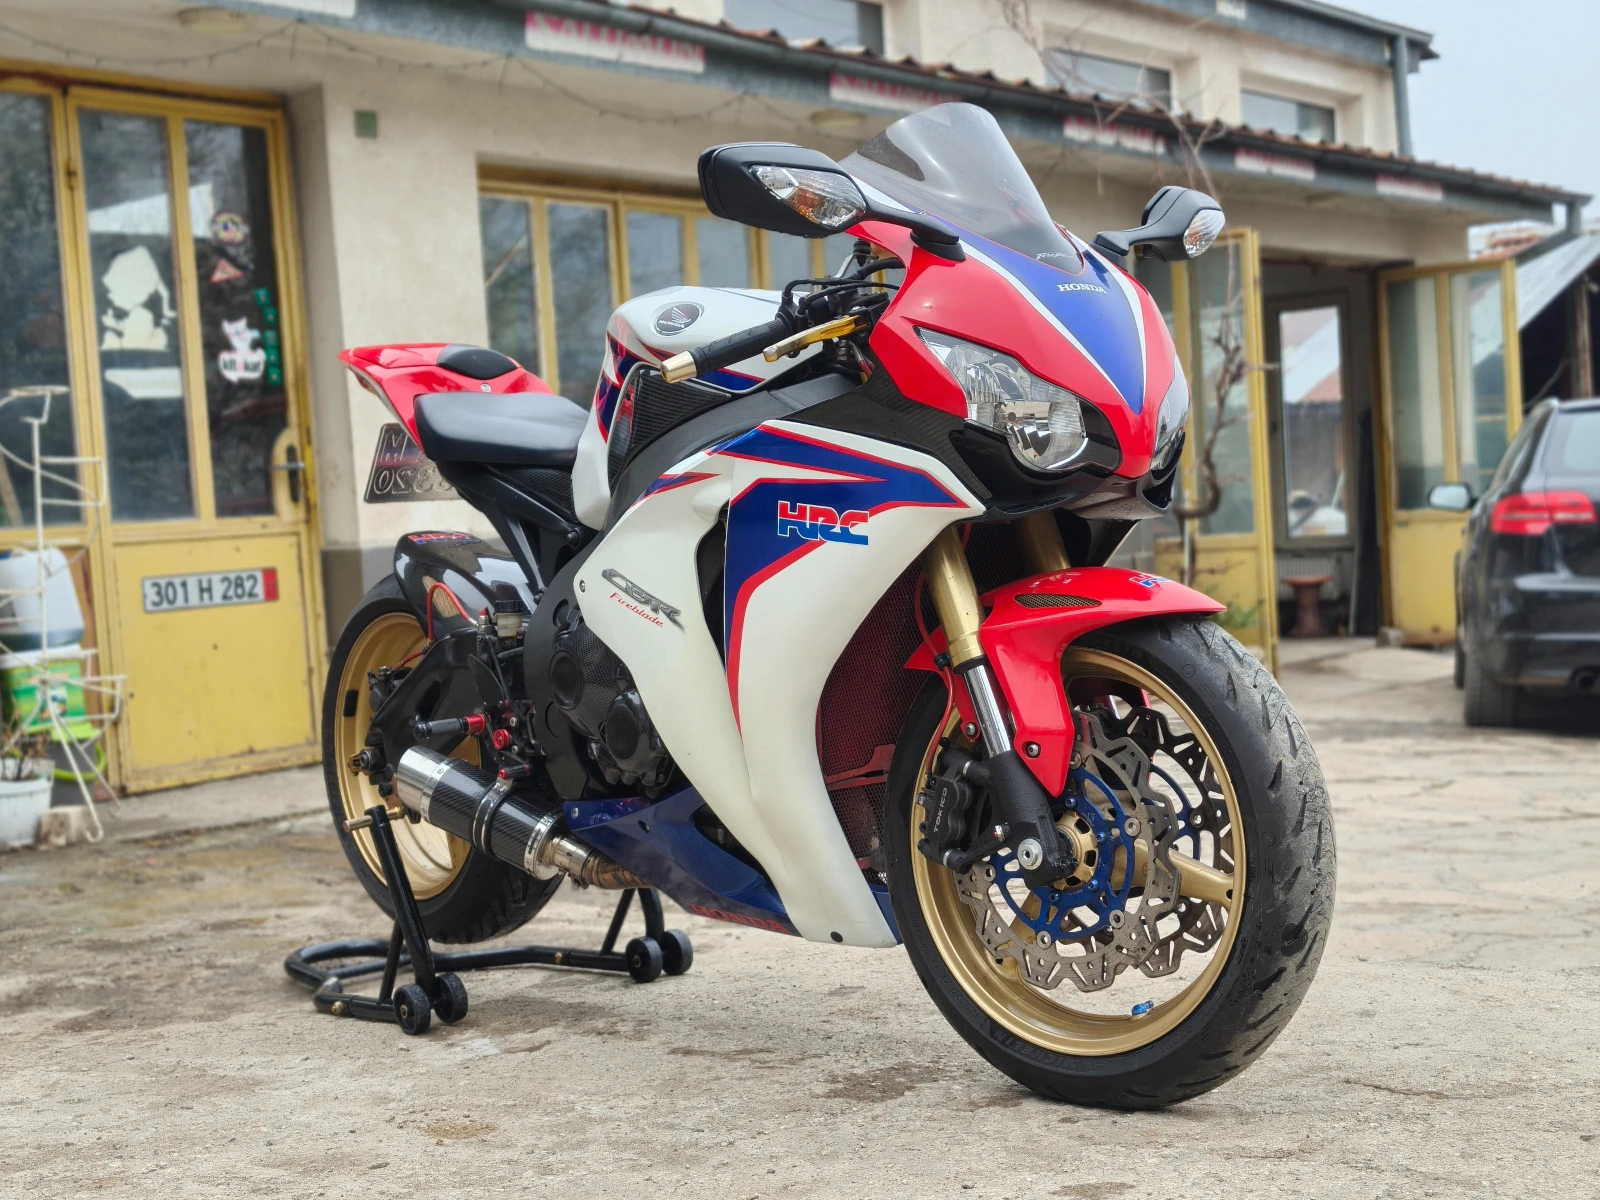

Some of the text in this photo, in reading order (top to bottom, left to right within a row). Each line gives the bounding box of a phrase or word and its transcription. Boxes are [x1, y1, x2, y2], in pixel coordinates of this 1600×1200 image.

[1056, 283, 1109, 295] HONDA
[657, 319, 685, 328] HONDA
[777, 500, 869, 546] HRC
[150, 580, 189, 607] 301
[198, 577, 213, 602] H
[220, 573, 259, 601] 282
[601, 568, 685, 632] CBR
[609, 592, 664, 628] Fireblade
[933, 787, 948, 833] TOKICO
[687, 903, 793, 934] HONDA
[991, 1025, 1077, 1070] MICHELIN
